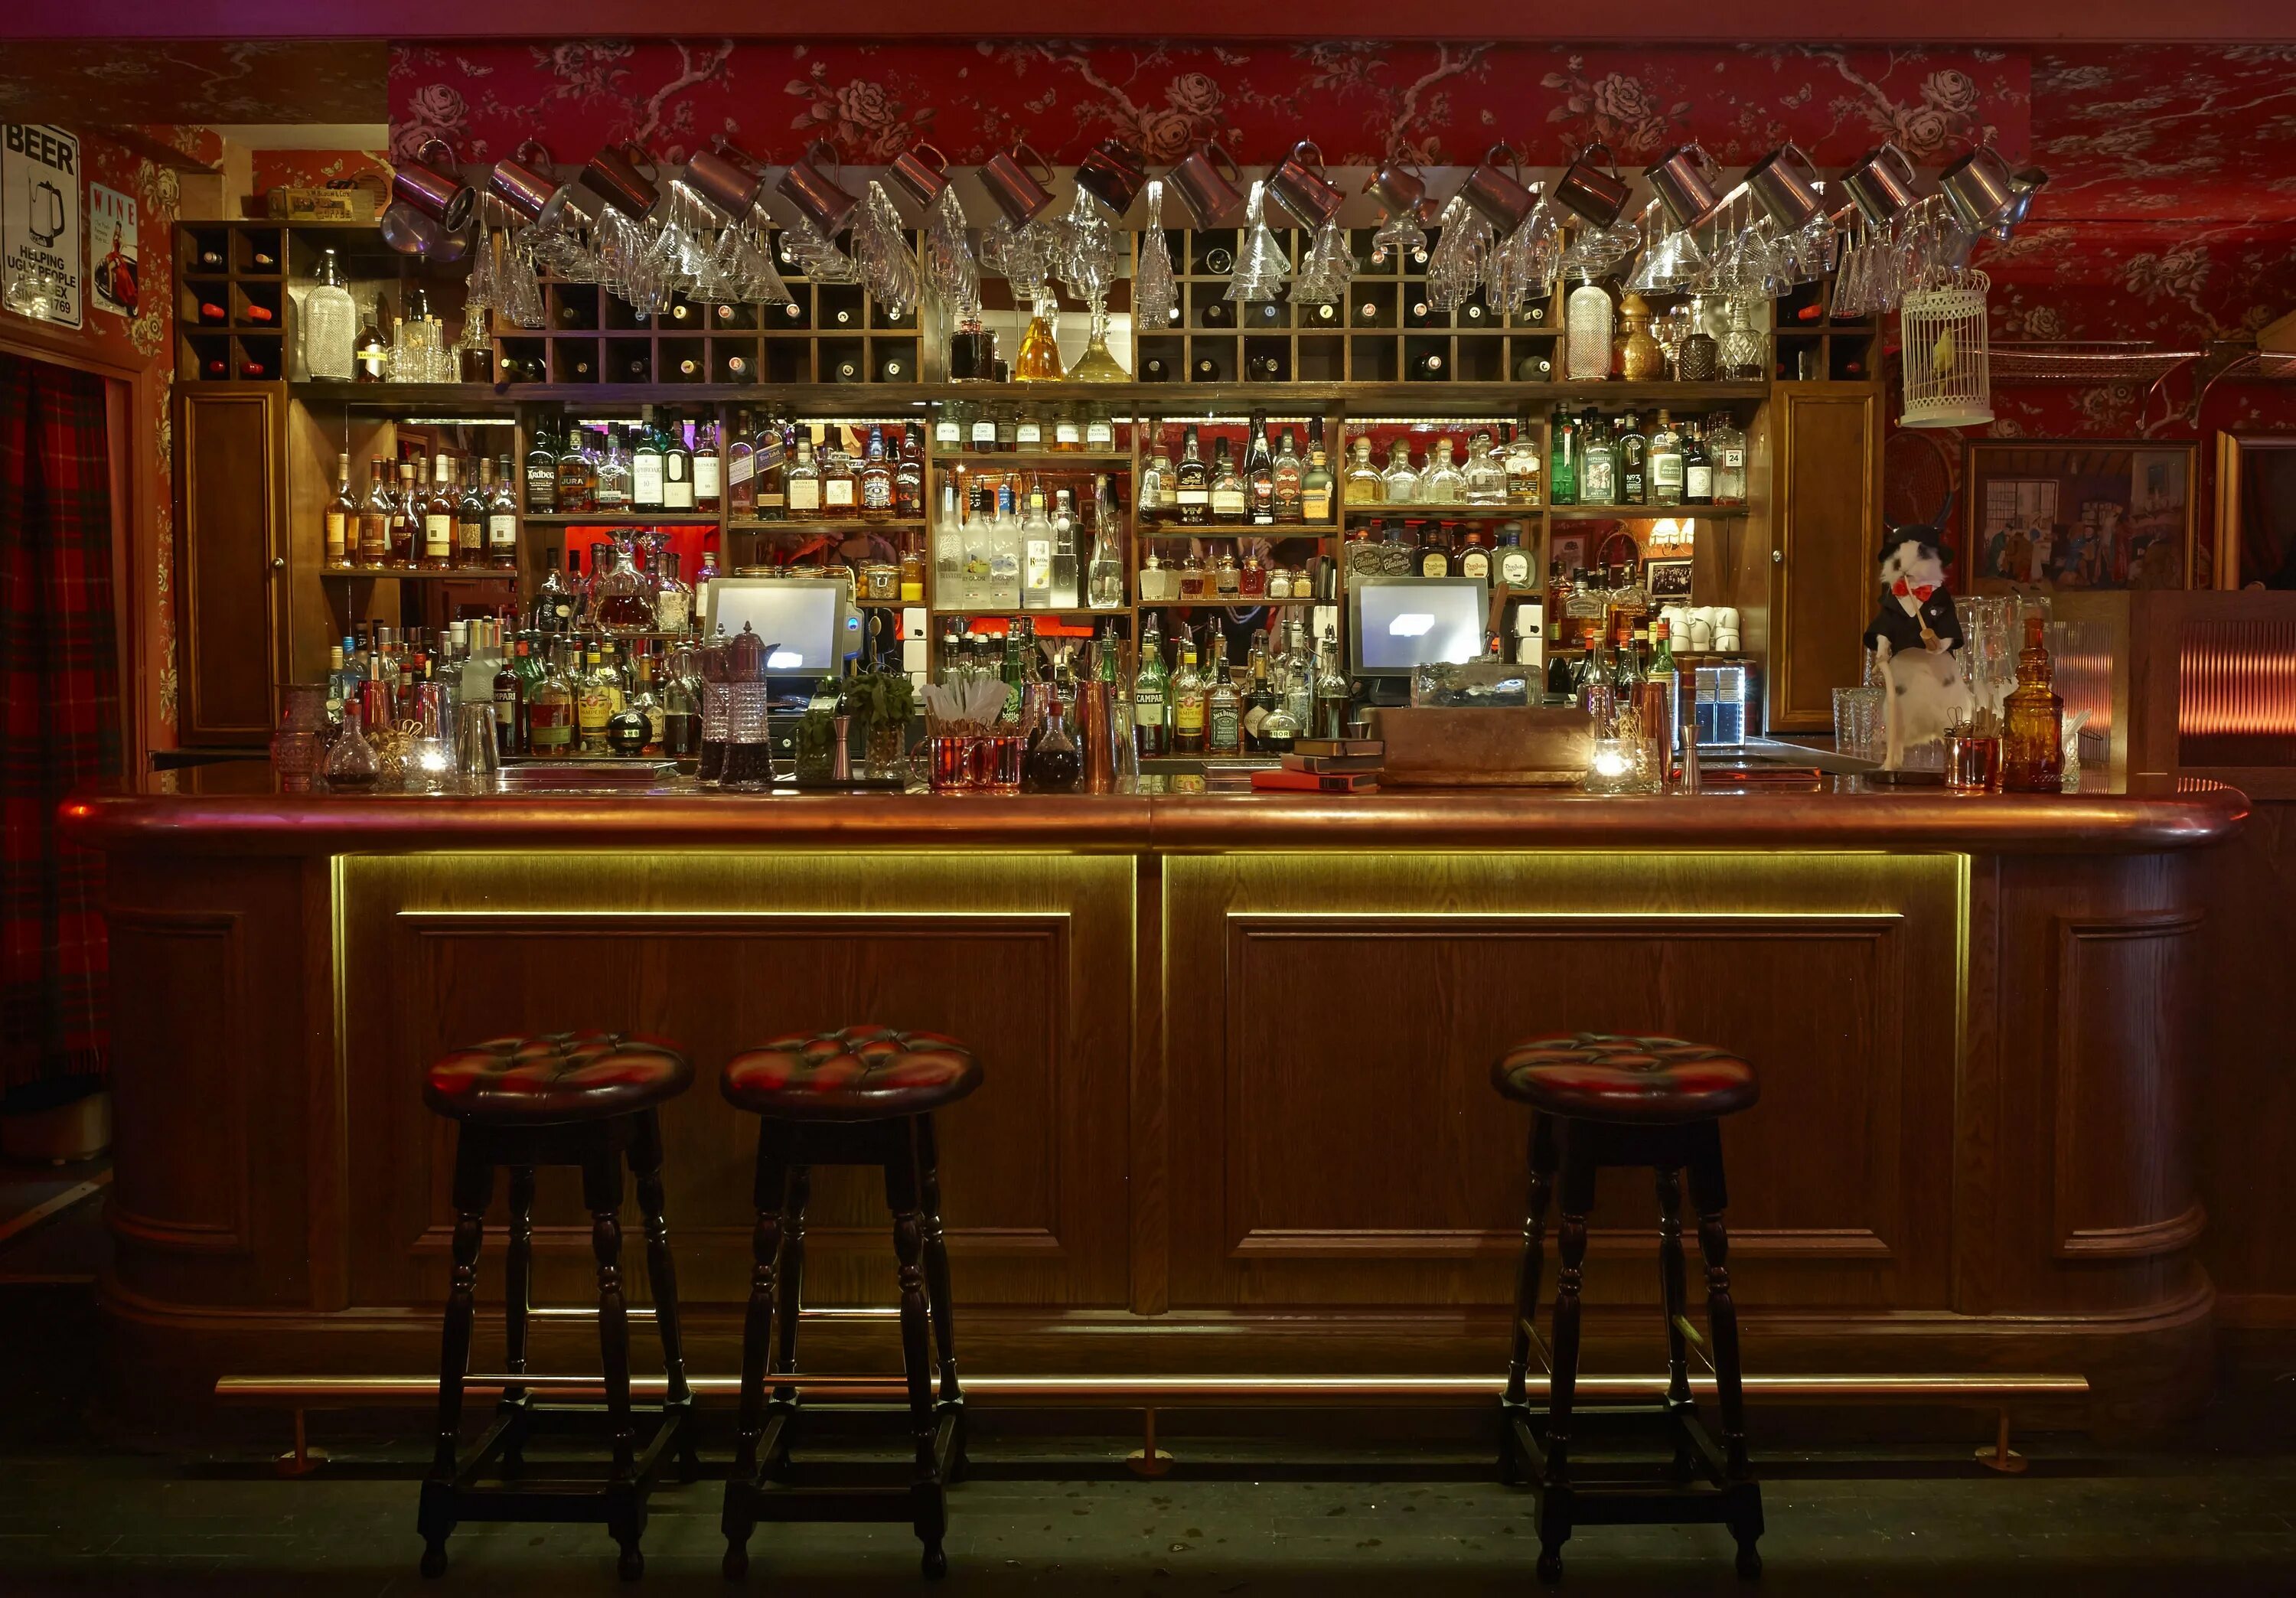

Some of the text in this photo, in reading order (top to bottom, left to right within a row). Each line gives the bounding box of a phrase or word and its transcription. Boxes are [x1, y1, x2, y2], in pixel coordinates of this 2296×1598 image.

[6, 124, 74, 175] BEER
[93, 189, 135, 226] WINE
[20, 245, 64, 270] HELPING
[7, 255, 76, 289] UGLY PEOPLE
[18, 273, 46, 292] HE
[50, 298, 70, 314] 1769
[494, 692, 516, 700] MPARI
[1136, 694, 1163, 703] CAMPAR
